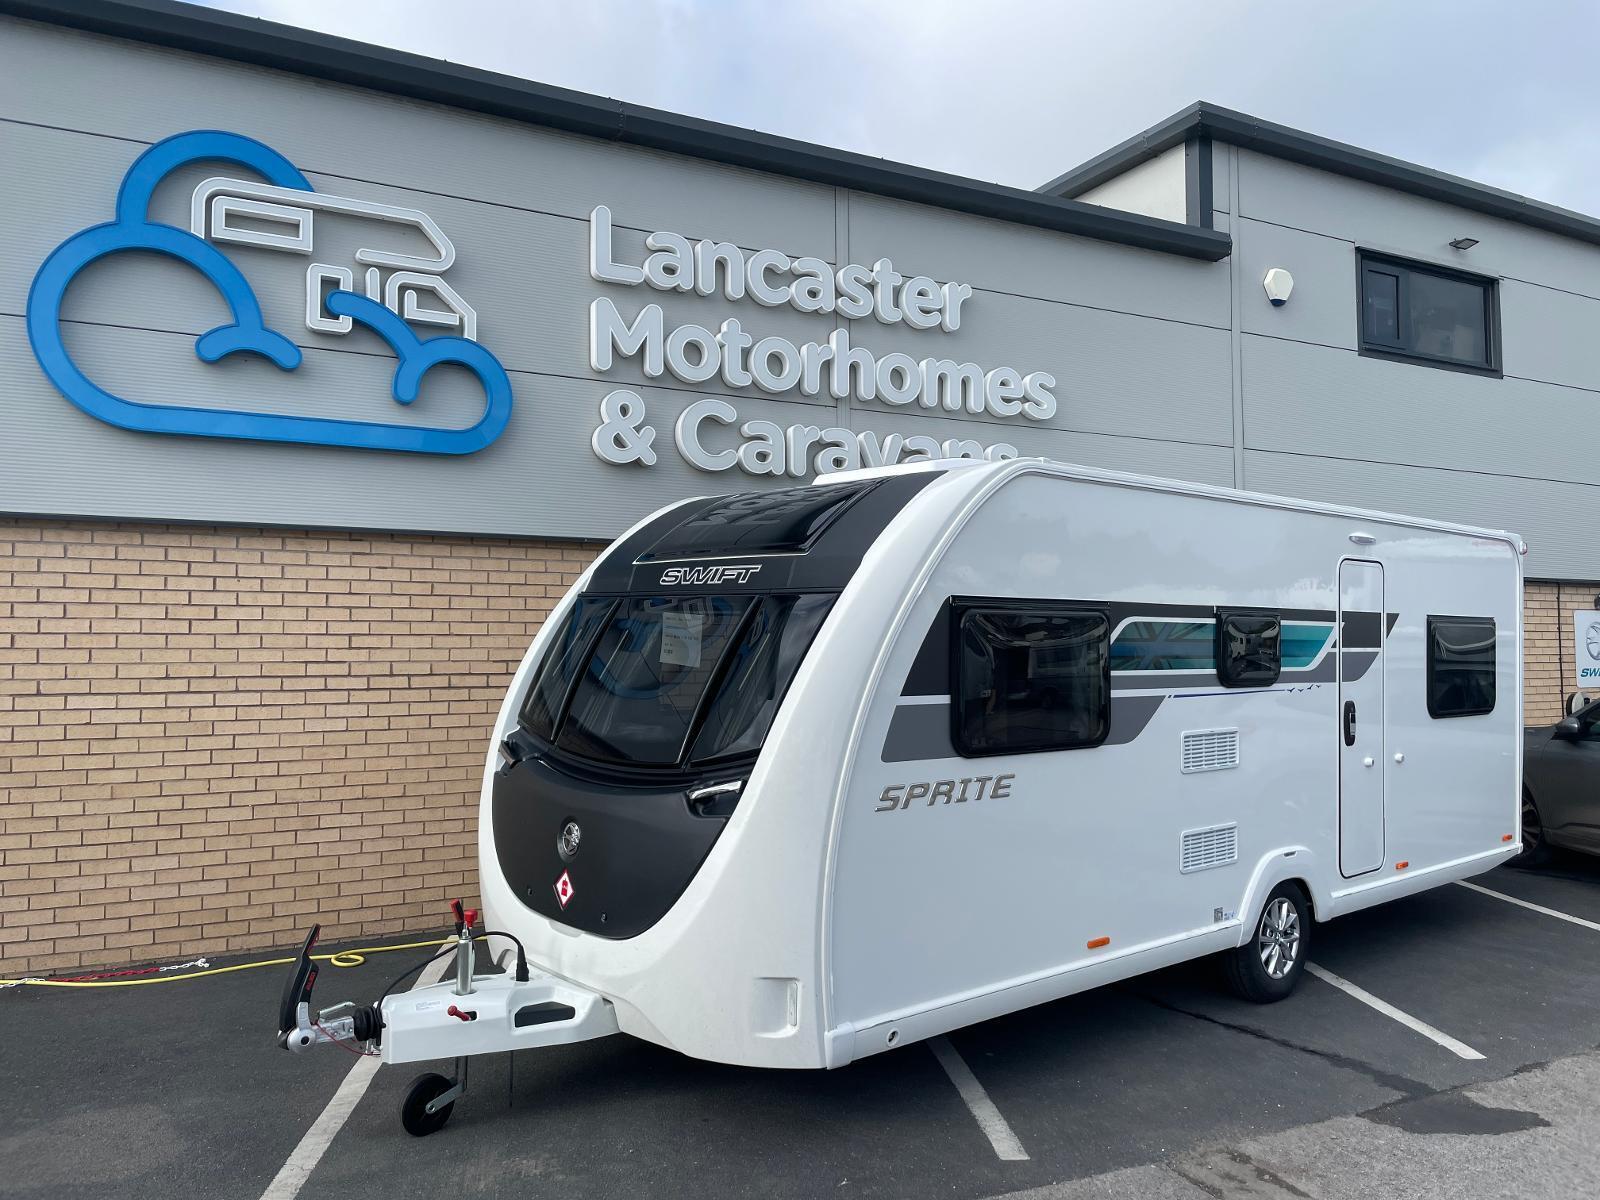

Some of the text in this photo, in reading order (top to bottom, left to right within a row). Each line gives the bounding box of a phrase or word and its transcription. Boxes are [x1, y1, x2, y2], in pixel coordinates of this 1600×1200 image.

[590, 205, 972, 332] Lancaster
[590, 297, 1057, 421] Motorhomes
[592, 390, 657, 467] &
[660, 564, 762, 586] SWIFT
[1580, 667, 1600, 678] SW
[874, 773, 1016, 812] SPRITE
